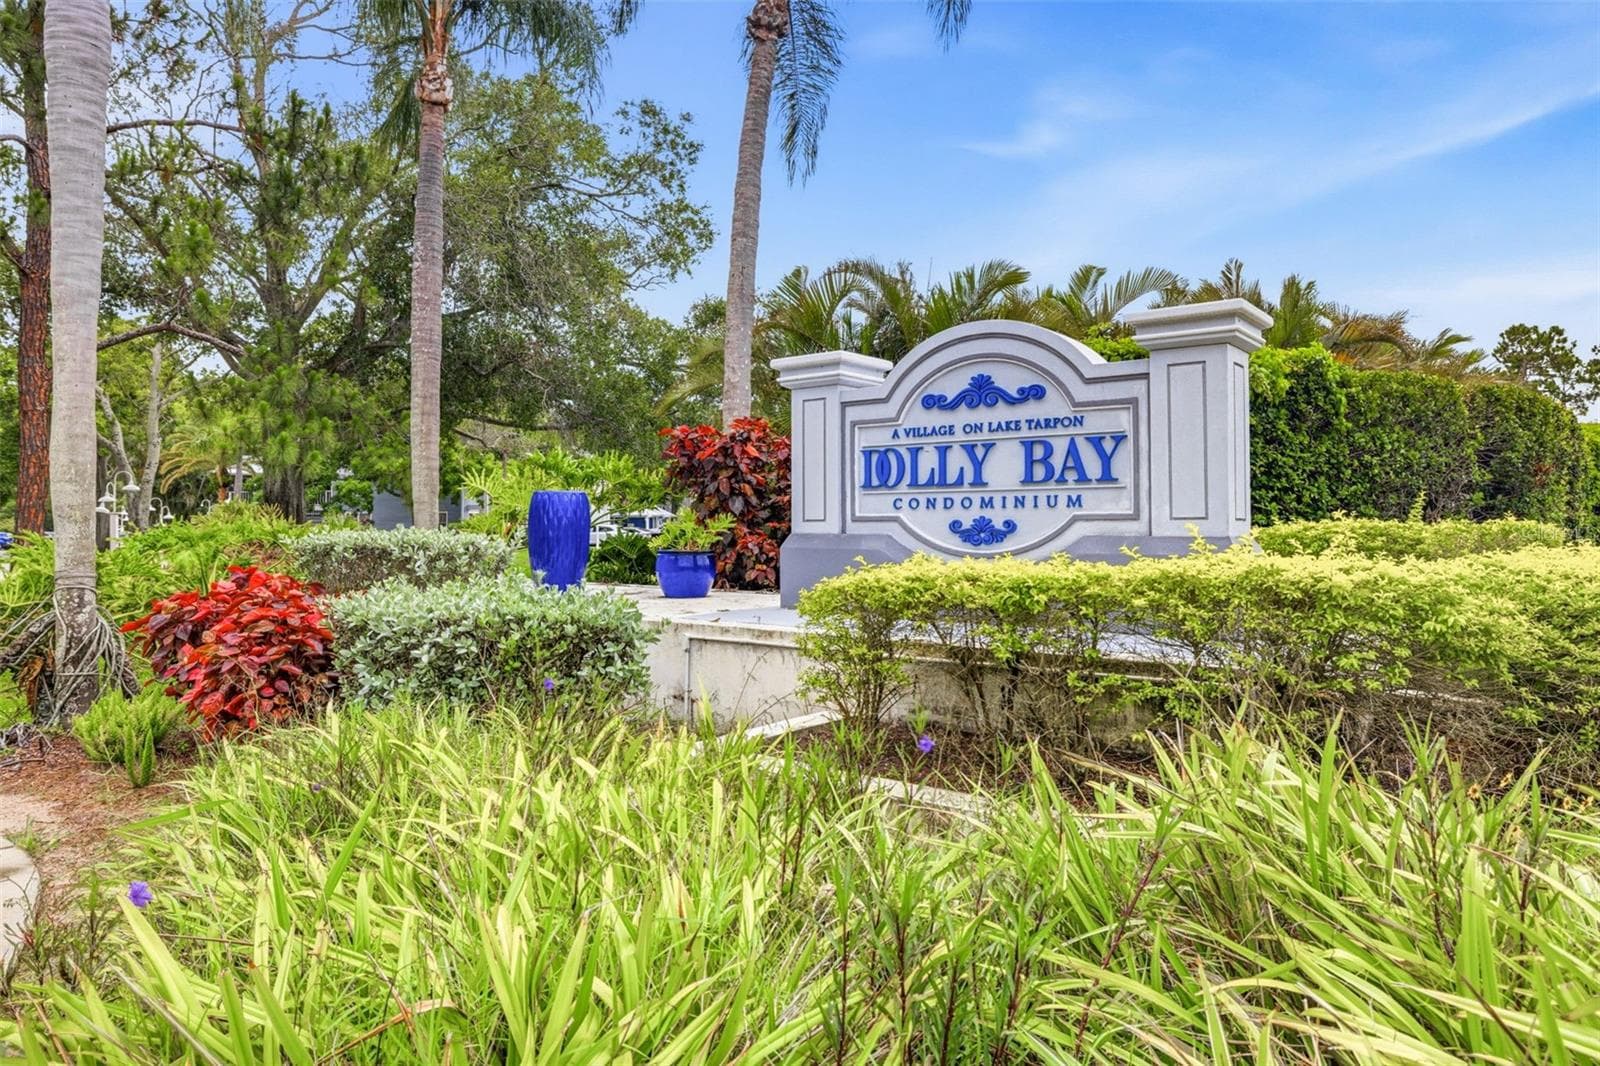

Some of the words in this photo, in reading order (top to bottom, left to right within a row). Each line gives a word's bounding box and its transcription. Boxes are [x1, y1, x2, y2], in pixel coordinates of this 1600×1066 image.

[892, 429, 900, 440] A
[903, 424, 955, 438] VILLAGE
[963, 422, 984, 435] ON
[988, 419, 1022, 433] LAKE
[1025, 415, 1085, 431] TARPON
[859, 442, 997, 489] DOLLY
[1018, 434, 1128, 485] BAY
[893, 494, 1083, 510] CONDOMINIUM
